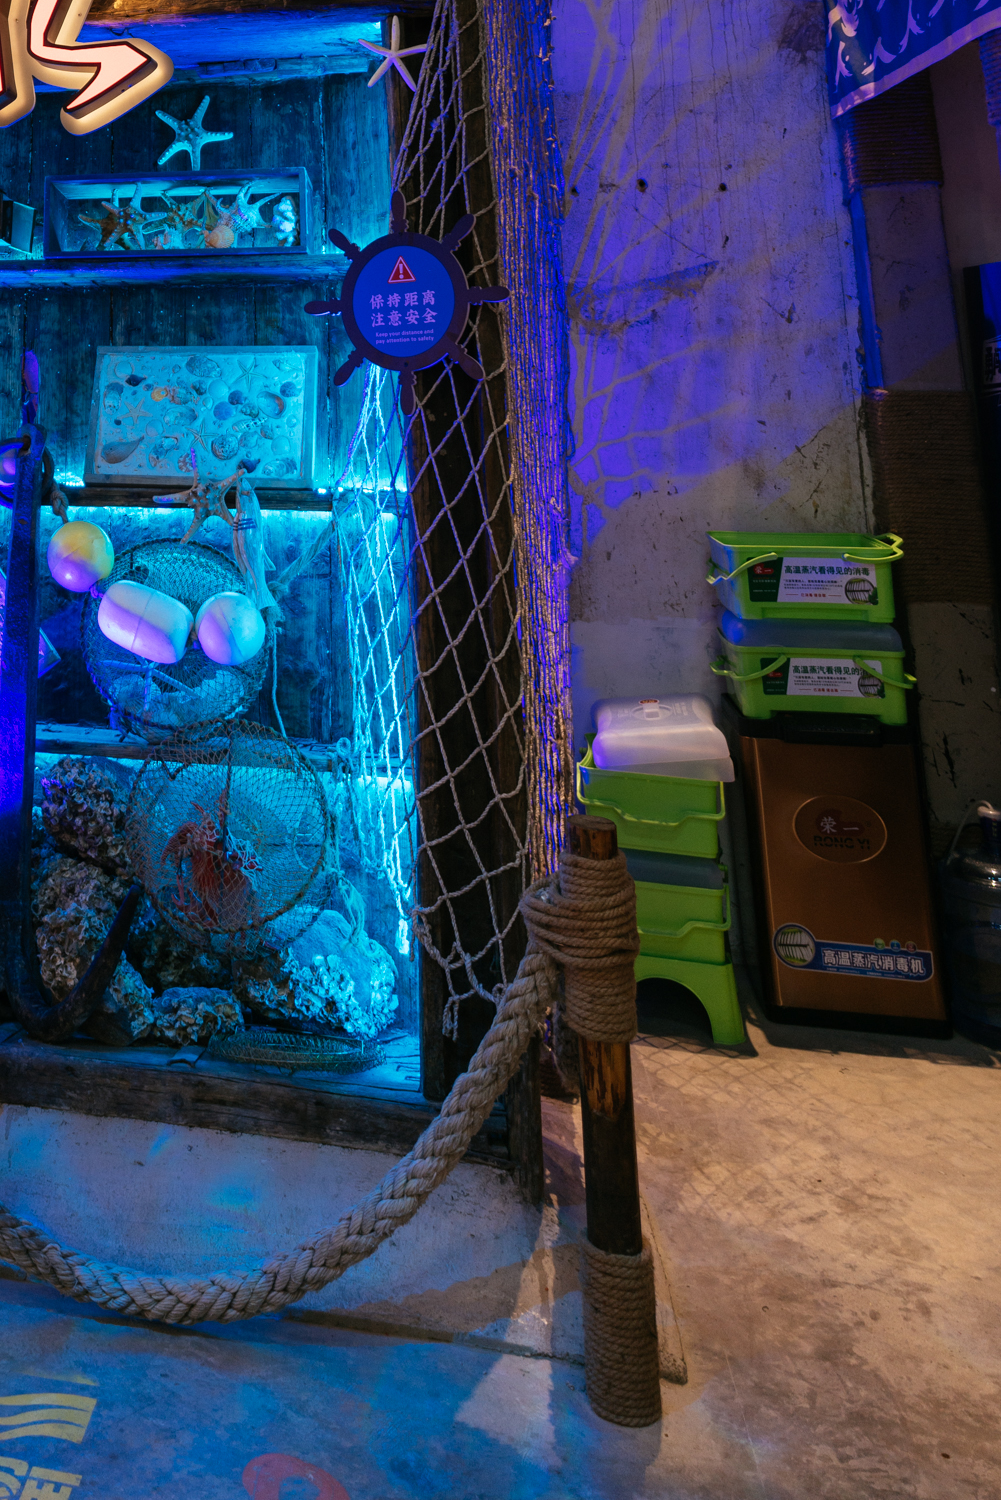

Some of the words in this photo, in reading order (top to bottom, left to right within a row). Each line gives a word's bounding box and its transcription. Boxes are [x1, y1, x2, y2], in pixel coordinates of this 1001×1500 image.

[369, 289, 436, 310] 保持距离
[370, 308, 438, 328] 注意安全
[784, 565, 870, 577] 高温蒸汽看得见的消毒
[792, 665, 876, 677] 高温蒸汽看得见的
[820, 816, 860, 834] 荣一
[813, 835, 855, 849] RONG
[823, 949, 925, 975] 高温蒸汽消毒机
